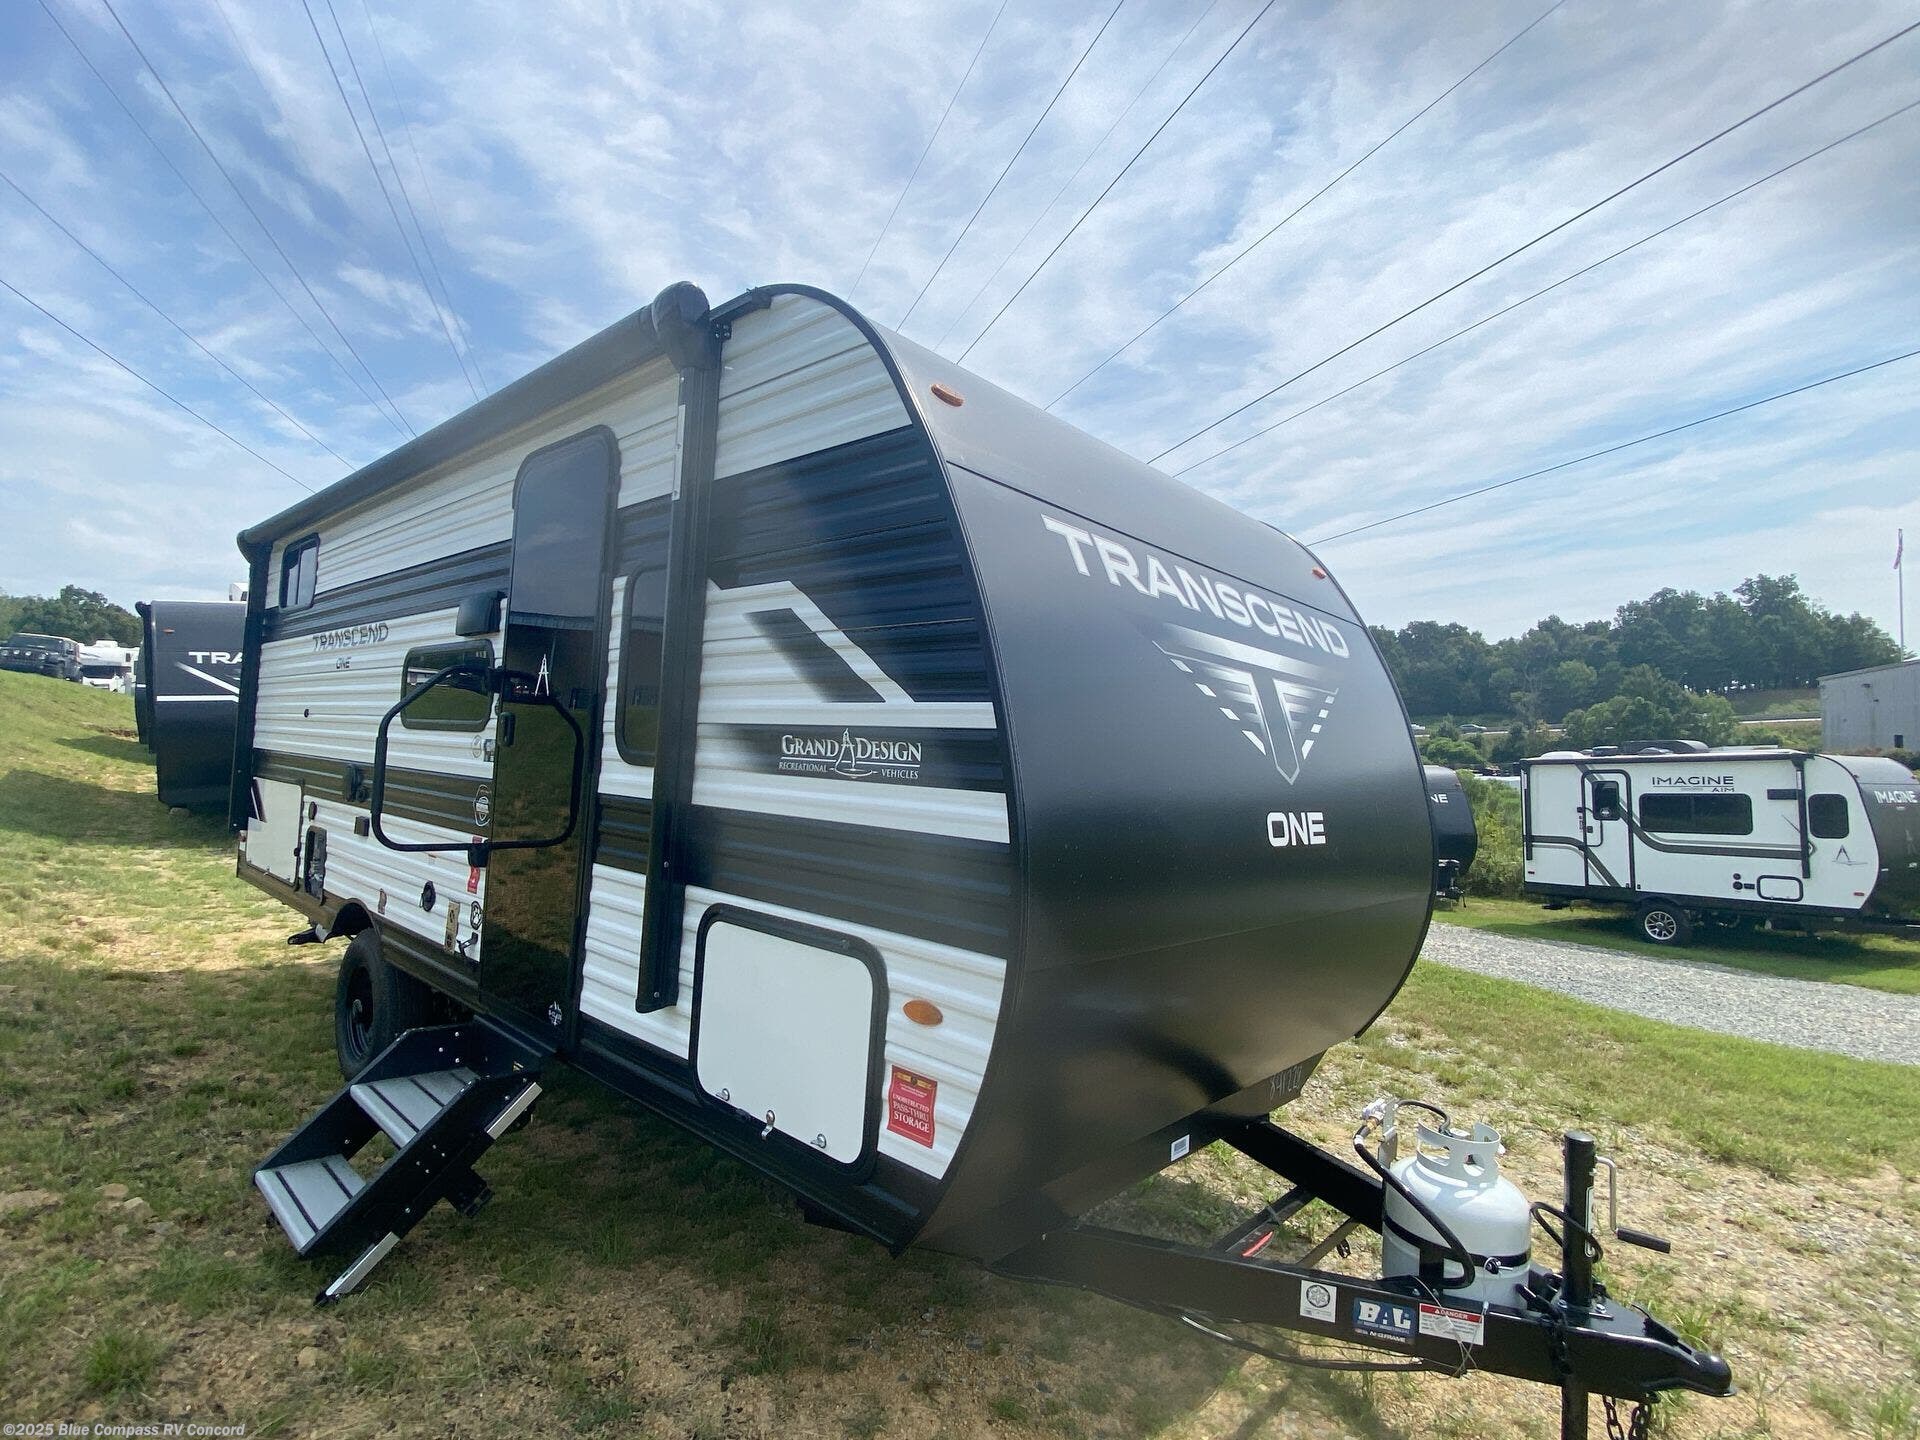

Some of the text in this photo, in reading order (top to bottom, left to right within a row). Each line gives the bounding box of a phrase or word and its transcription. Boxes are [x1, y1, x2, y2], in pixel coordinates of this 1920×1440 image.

[1041, 513, 1349, 659] TRANSCEND
[312, 622, 389, 649] TRANSCEND
[781, 734, 922, 762] GRAND DESIGN
[778, 761, 919, 780] RECREATIONAL VEHICLES
[1652, 776, 1734, 785] IMAGINE
[1873, 790, 1918, 804] IMAGINE
[1266, 811, 1326, 847] ONE
[894, 1110, 930, 1133] STORAGE
[1440, 1309, 1468, 1320] DANGER
